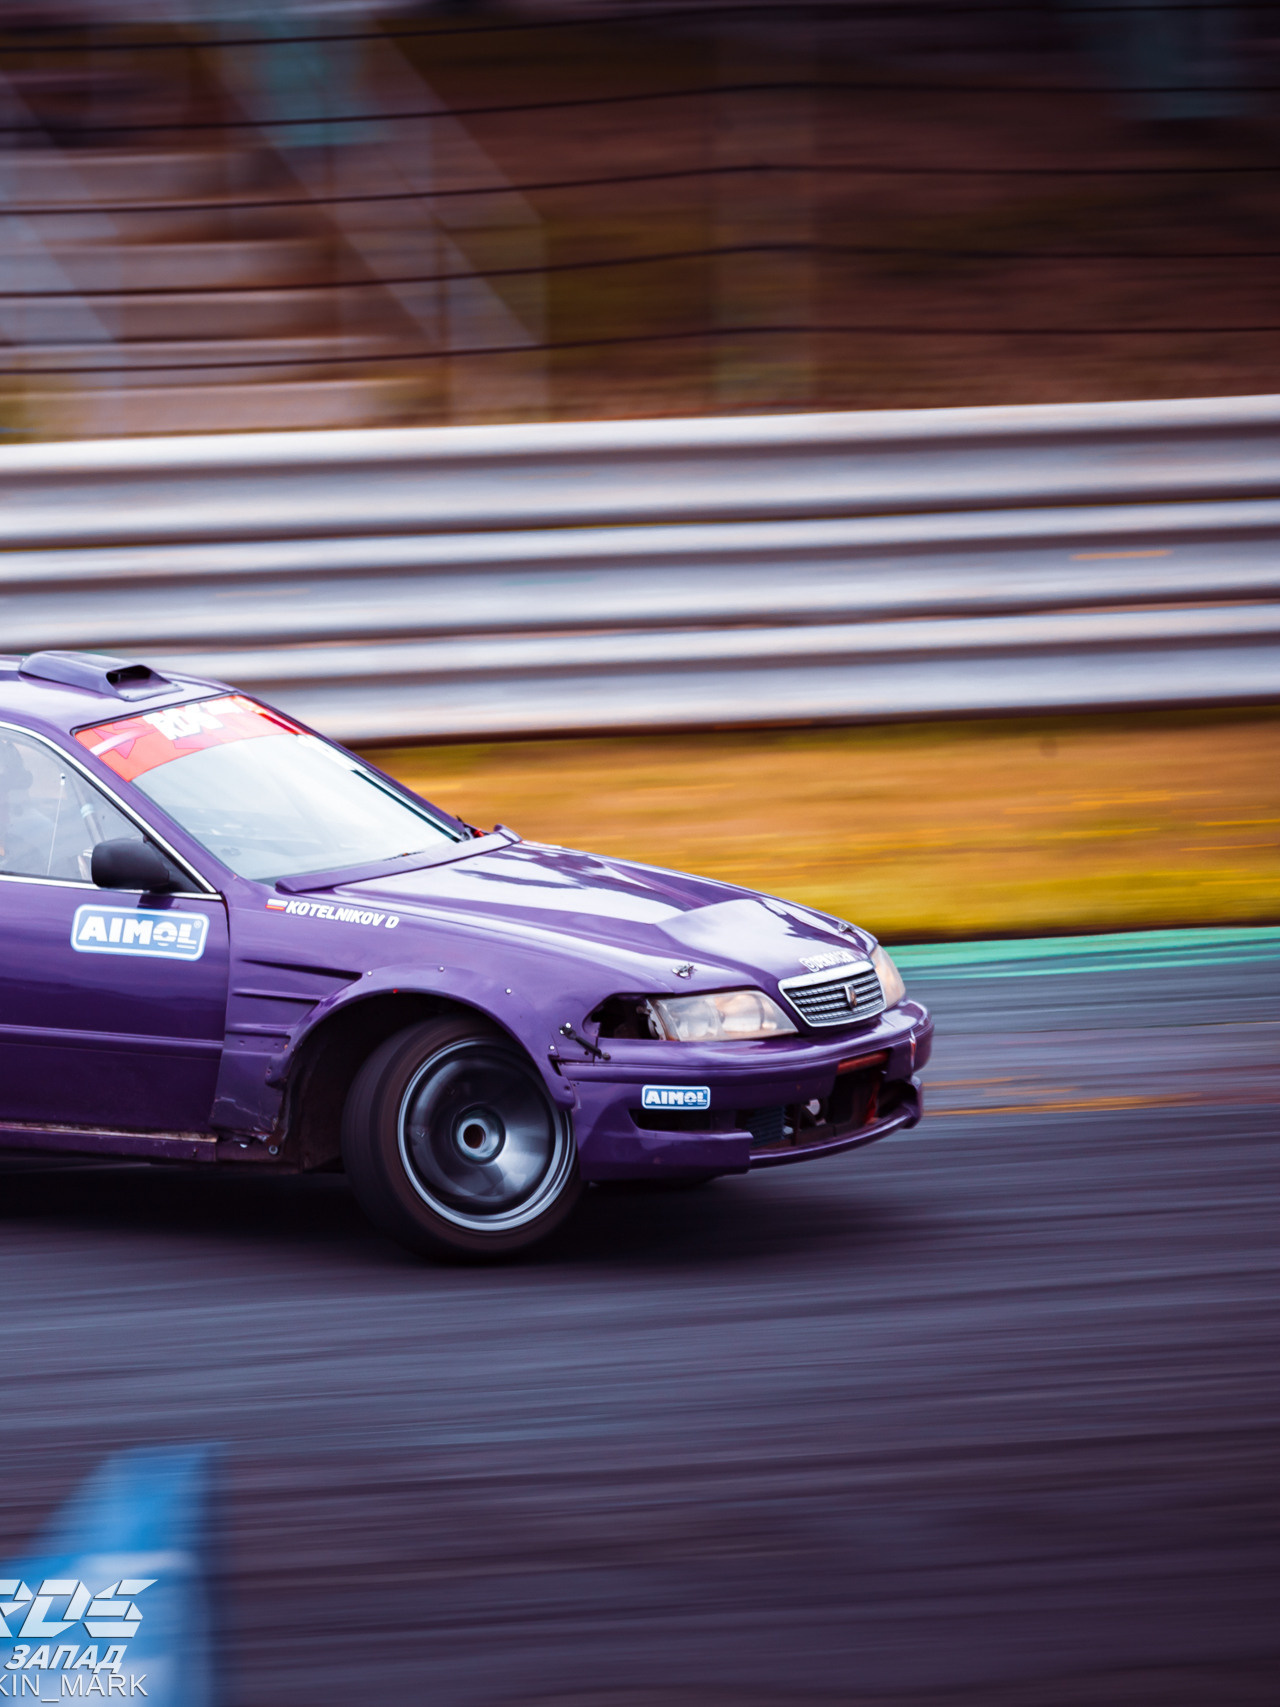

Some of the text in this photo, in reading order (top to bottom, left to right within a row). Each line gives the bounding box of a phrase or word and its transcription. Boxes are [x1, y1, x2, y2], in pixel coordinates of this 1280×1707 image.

[285, 901, 400, 929] KOTELNIKOV D
[78, 915, 198, 950] AIMOL
[645, 1090, 707, 1105] AIMOL
